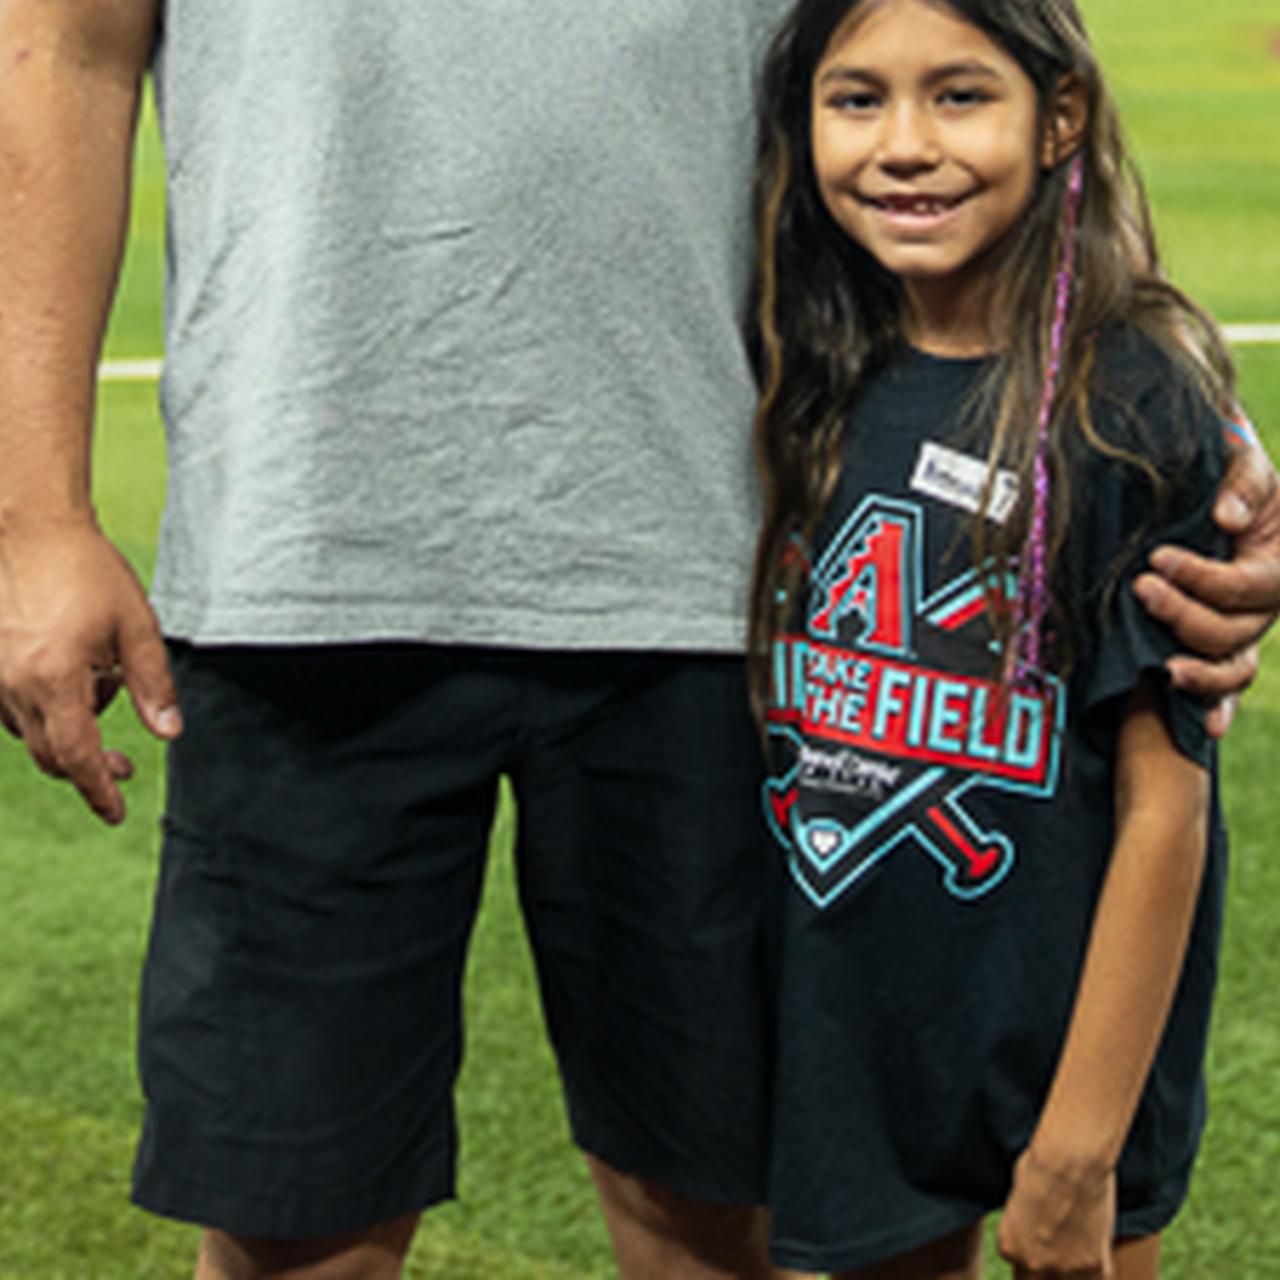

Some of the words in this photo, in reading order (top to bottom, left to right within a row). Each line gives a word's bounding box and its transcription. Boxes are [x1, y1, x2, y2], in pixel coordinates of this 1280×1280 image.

[808, 496, 923, 658] A
[806, 681, 866, 734] THE
[872, 666, 1045, 770] FIELD
